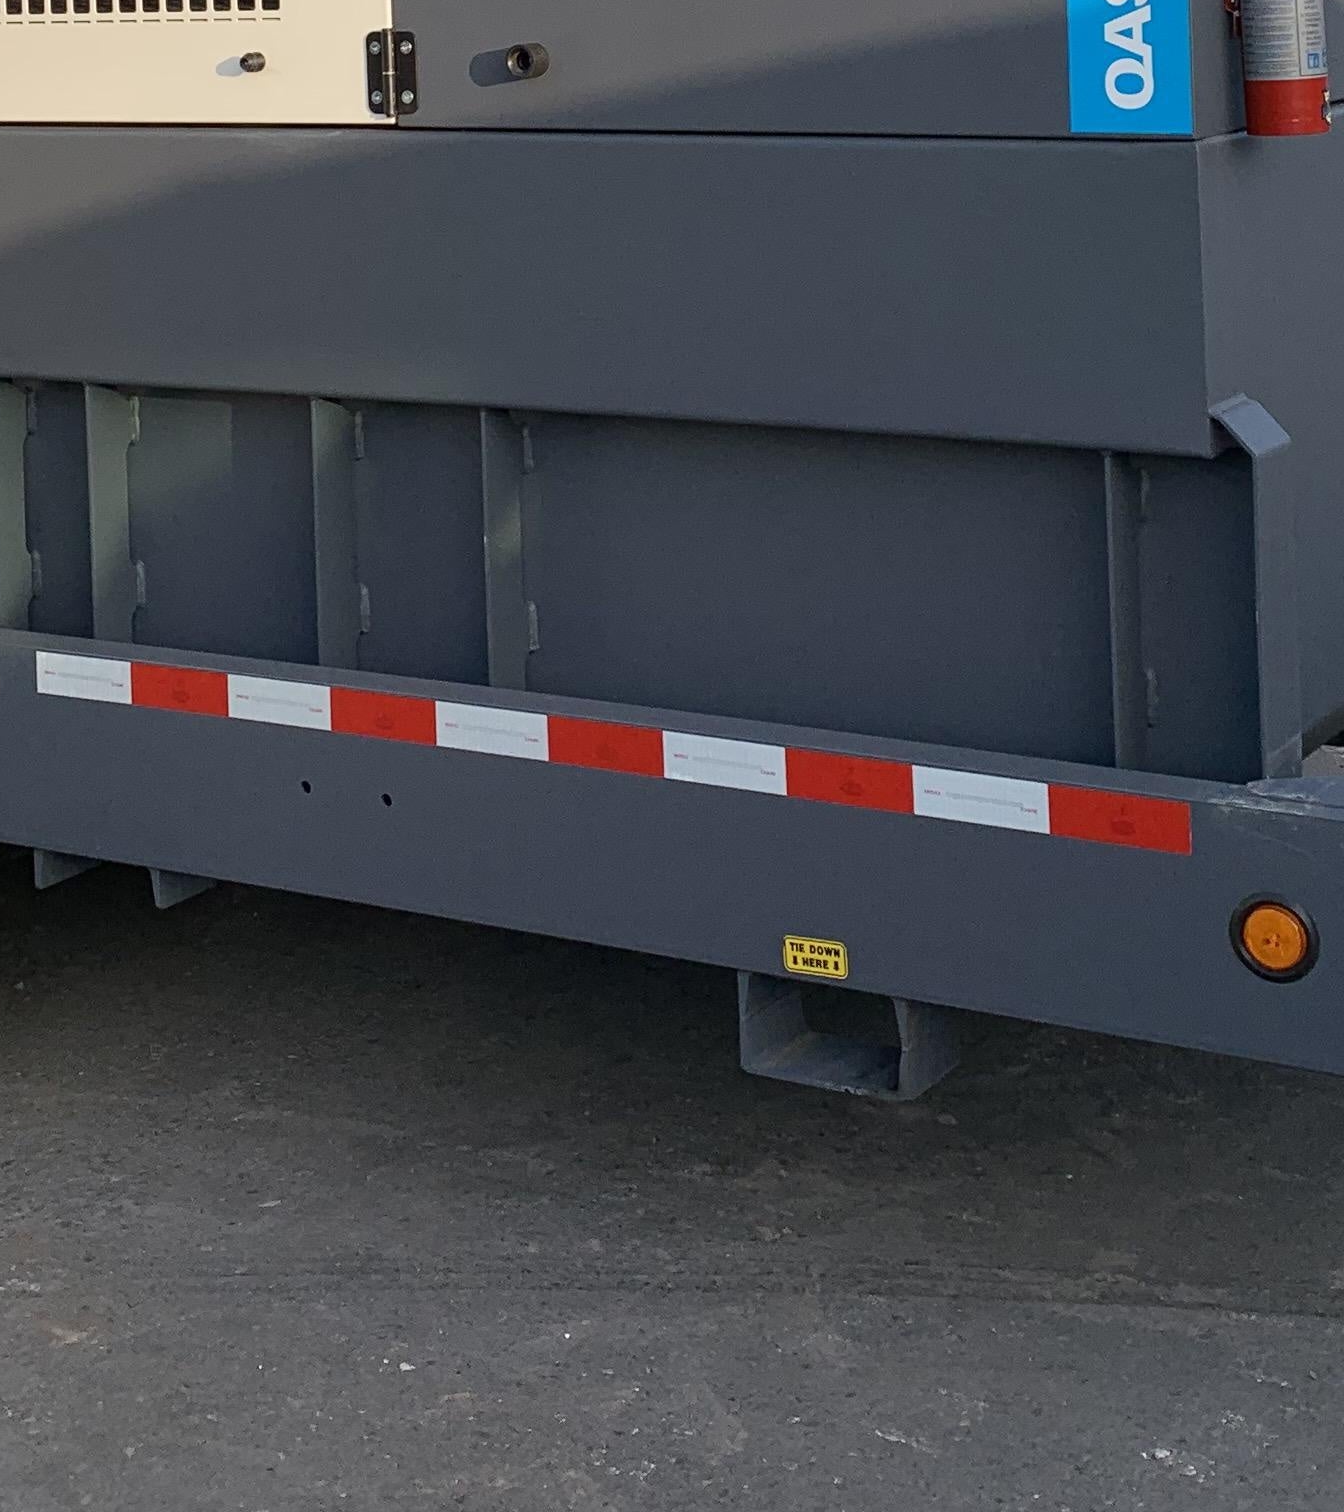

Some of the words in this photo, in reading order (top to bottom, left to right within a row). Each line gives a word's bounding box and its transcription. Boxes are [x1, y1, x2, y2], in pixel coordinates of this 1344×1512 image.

[789, 941, 806, 953] TIE
[809, 944, 841, 958] DOWN
[802, 957, 830, 970] HERE
